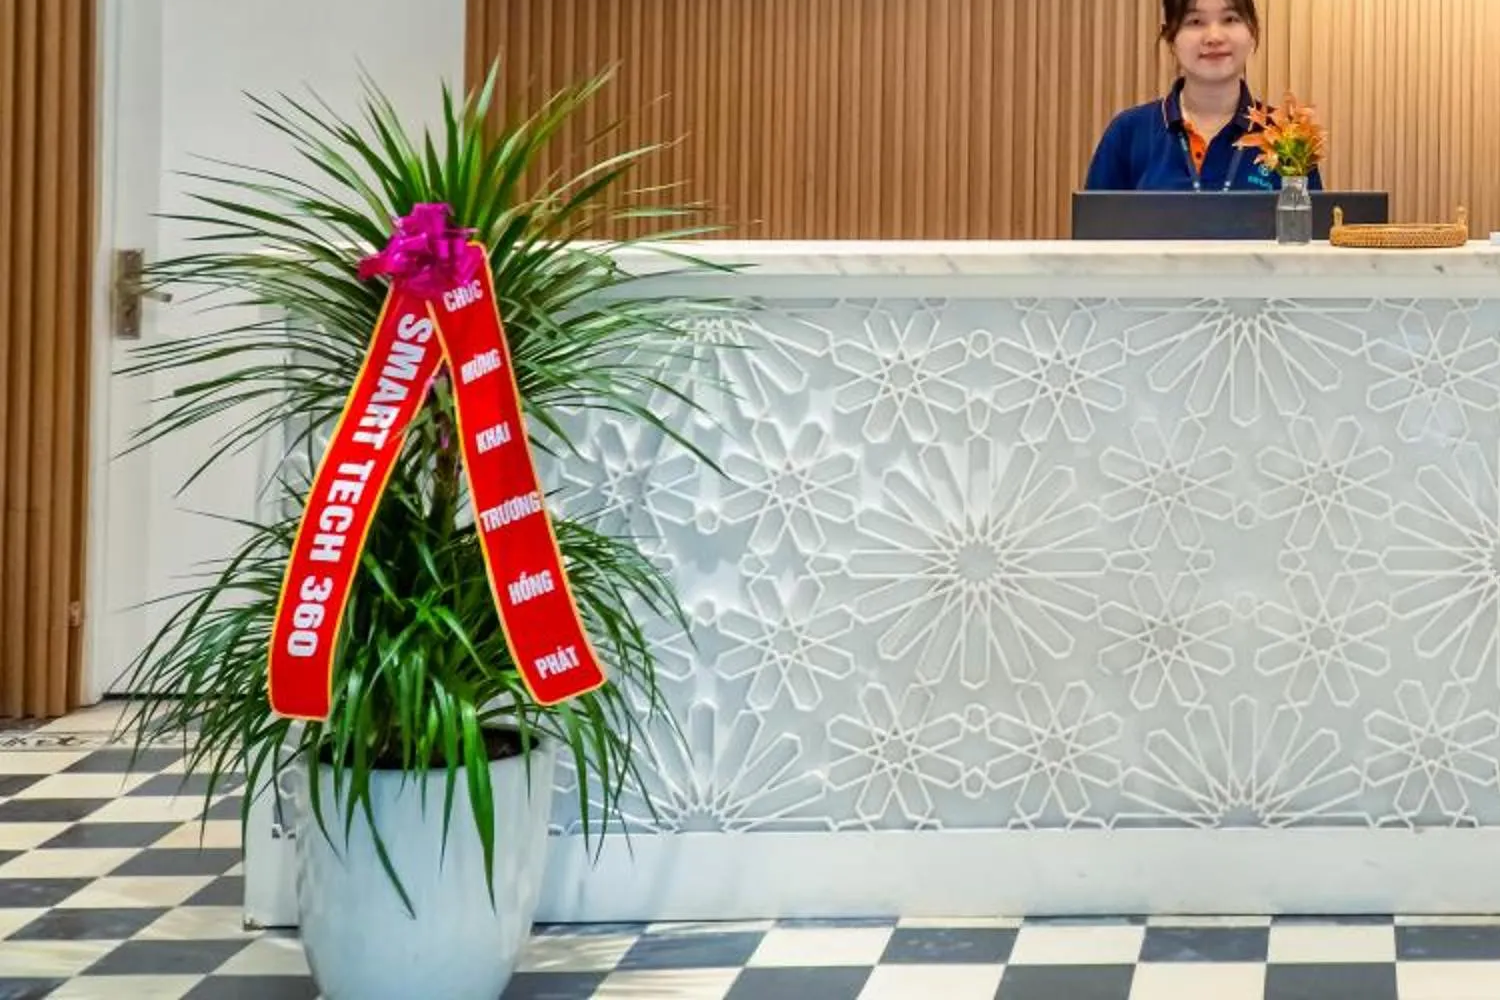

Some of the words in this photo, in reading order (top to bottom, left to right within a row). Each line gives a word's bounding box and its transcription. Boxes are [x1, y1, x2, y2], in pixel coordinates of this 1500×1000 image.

[352, 313, 433, 450] SMART
[475, 421, 512, 455] KHAI
[309, 459, 376, 562] TECH
[287, 575, 333, 657] 360
[534, 645, 580, 680] PHÁT
